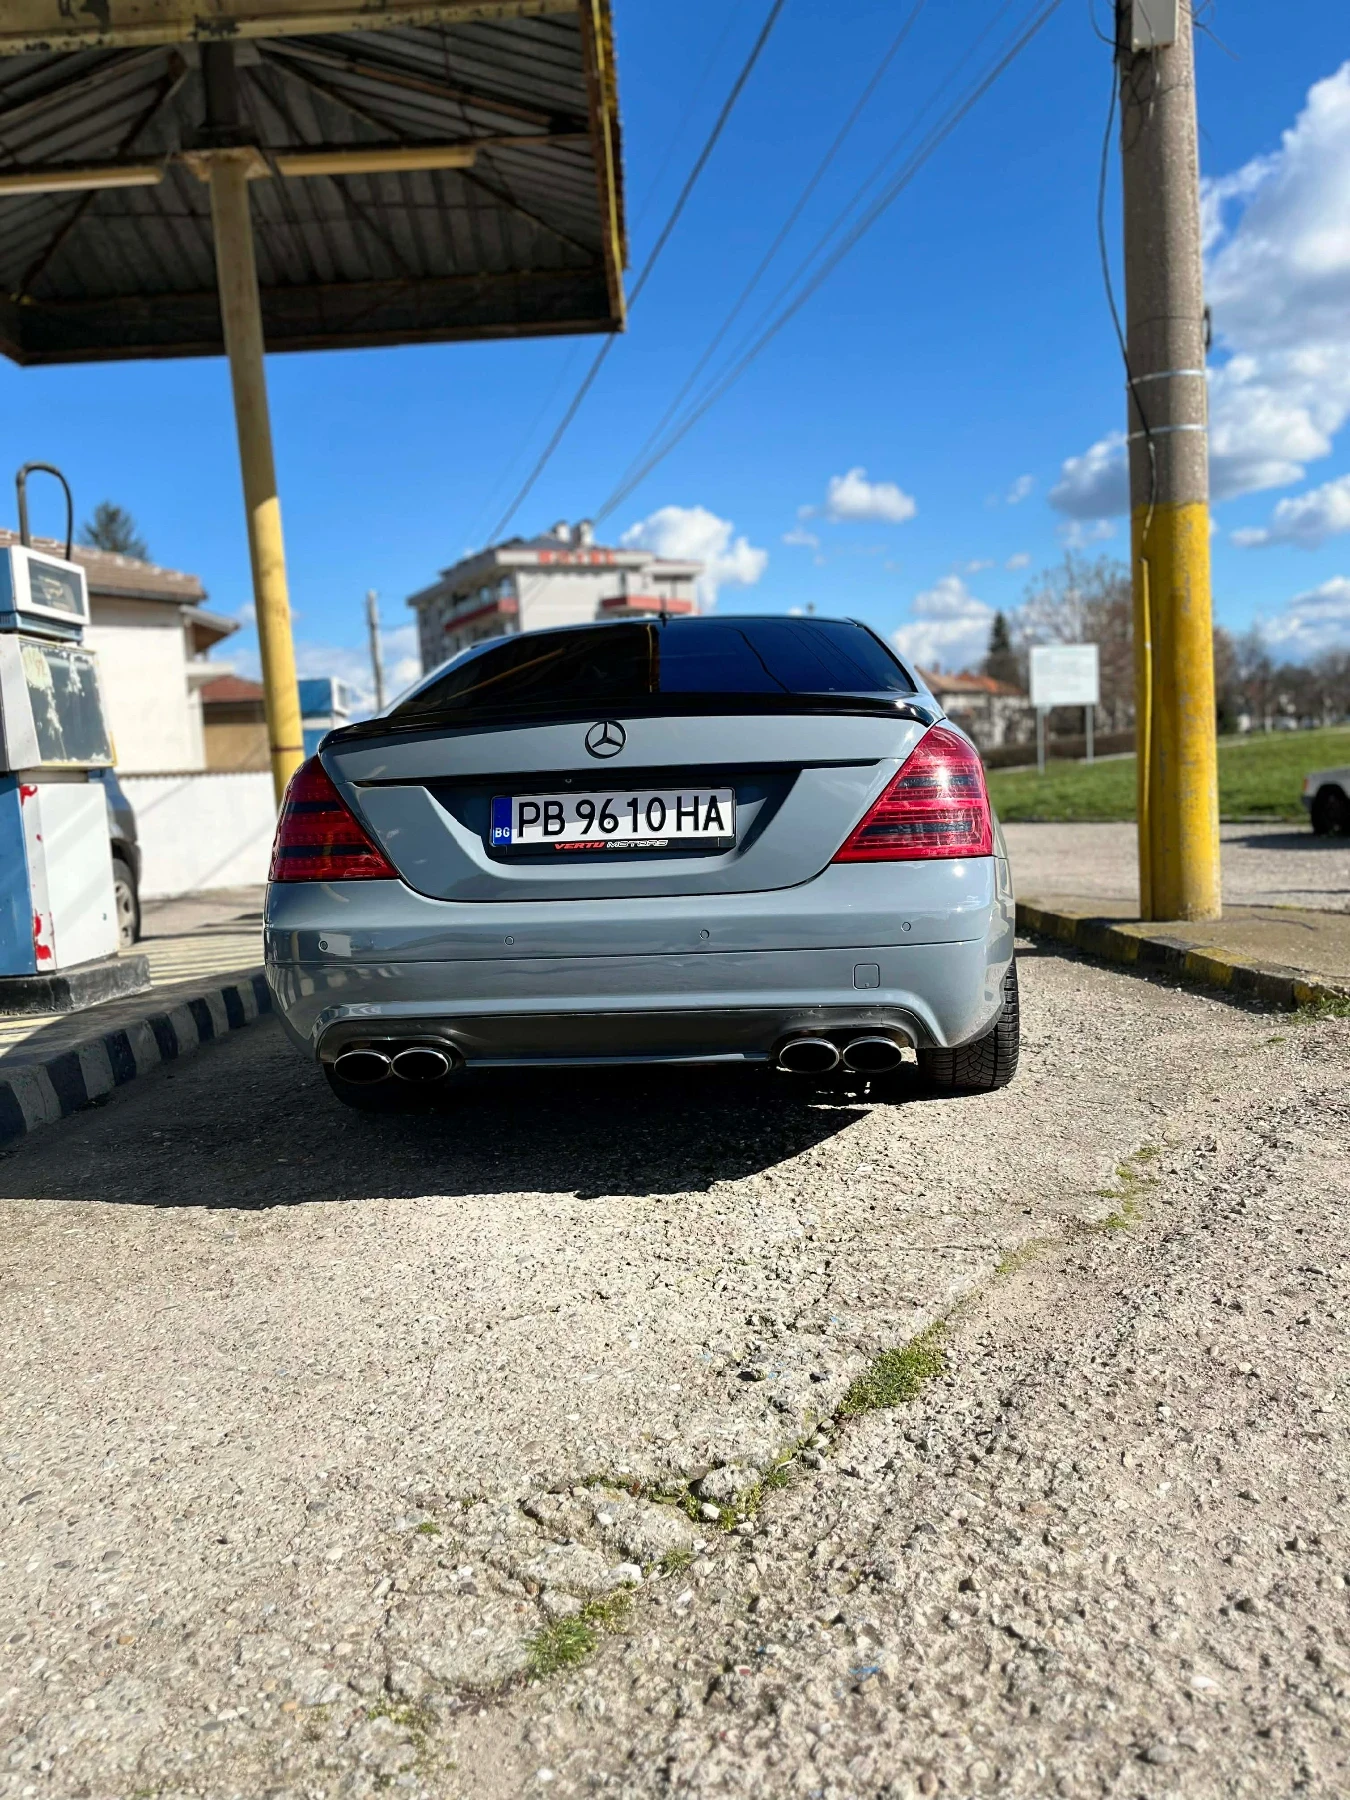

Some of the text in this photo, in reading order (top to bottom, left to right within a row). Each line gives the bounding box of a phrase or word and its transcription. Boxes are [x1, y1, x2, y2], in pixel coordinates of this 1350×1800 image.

[517, 796, 725, 838] PB 9610 HA
[494, 827, 510, 838] BG
[554, 839, 669, 850] VERTU MOTORS
